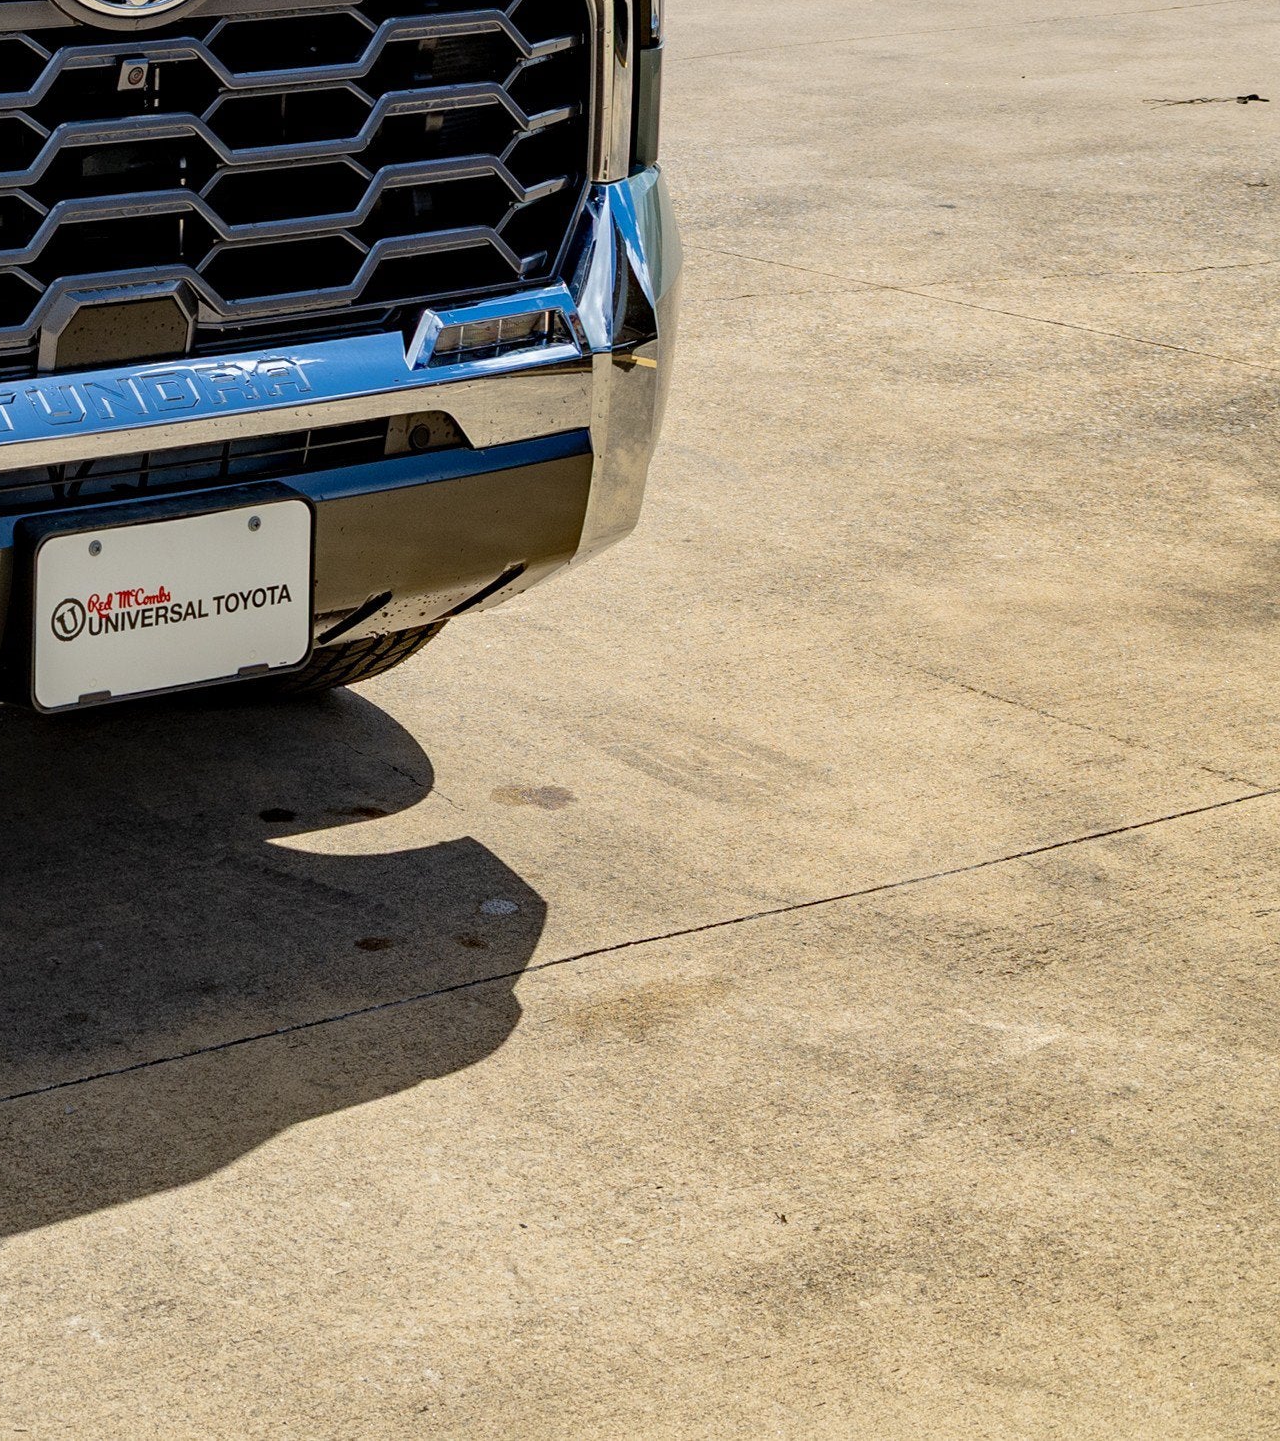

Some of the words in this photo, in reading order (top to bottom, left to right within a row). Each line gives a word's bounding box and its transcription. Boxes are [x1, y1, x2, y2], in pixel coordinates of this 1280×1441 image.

[87, 592, 113, 618] Red
[114, 585, 171, 609] McCombs
[88, 601, 209, 636] UNIVERSAL
[213, 583, 293, 616] TOYOTA
